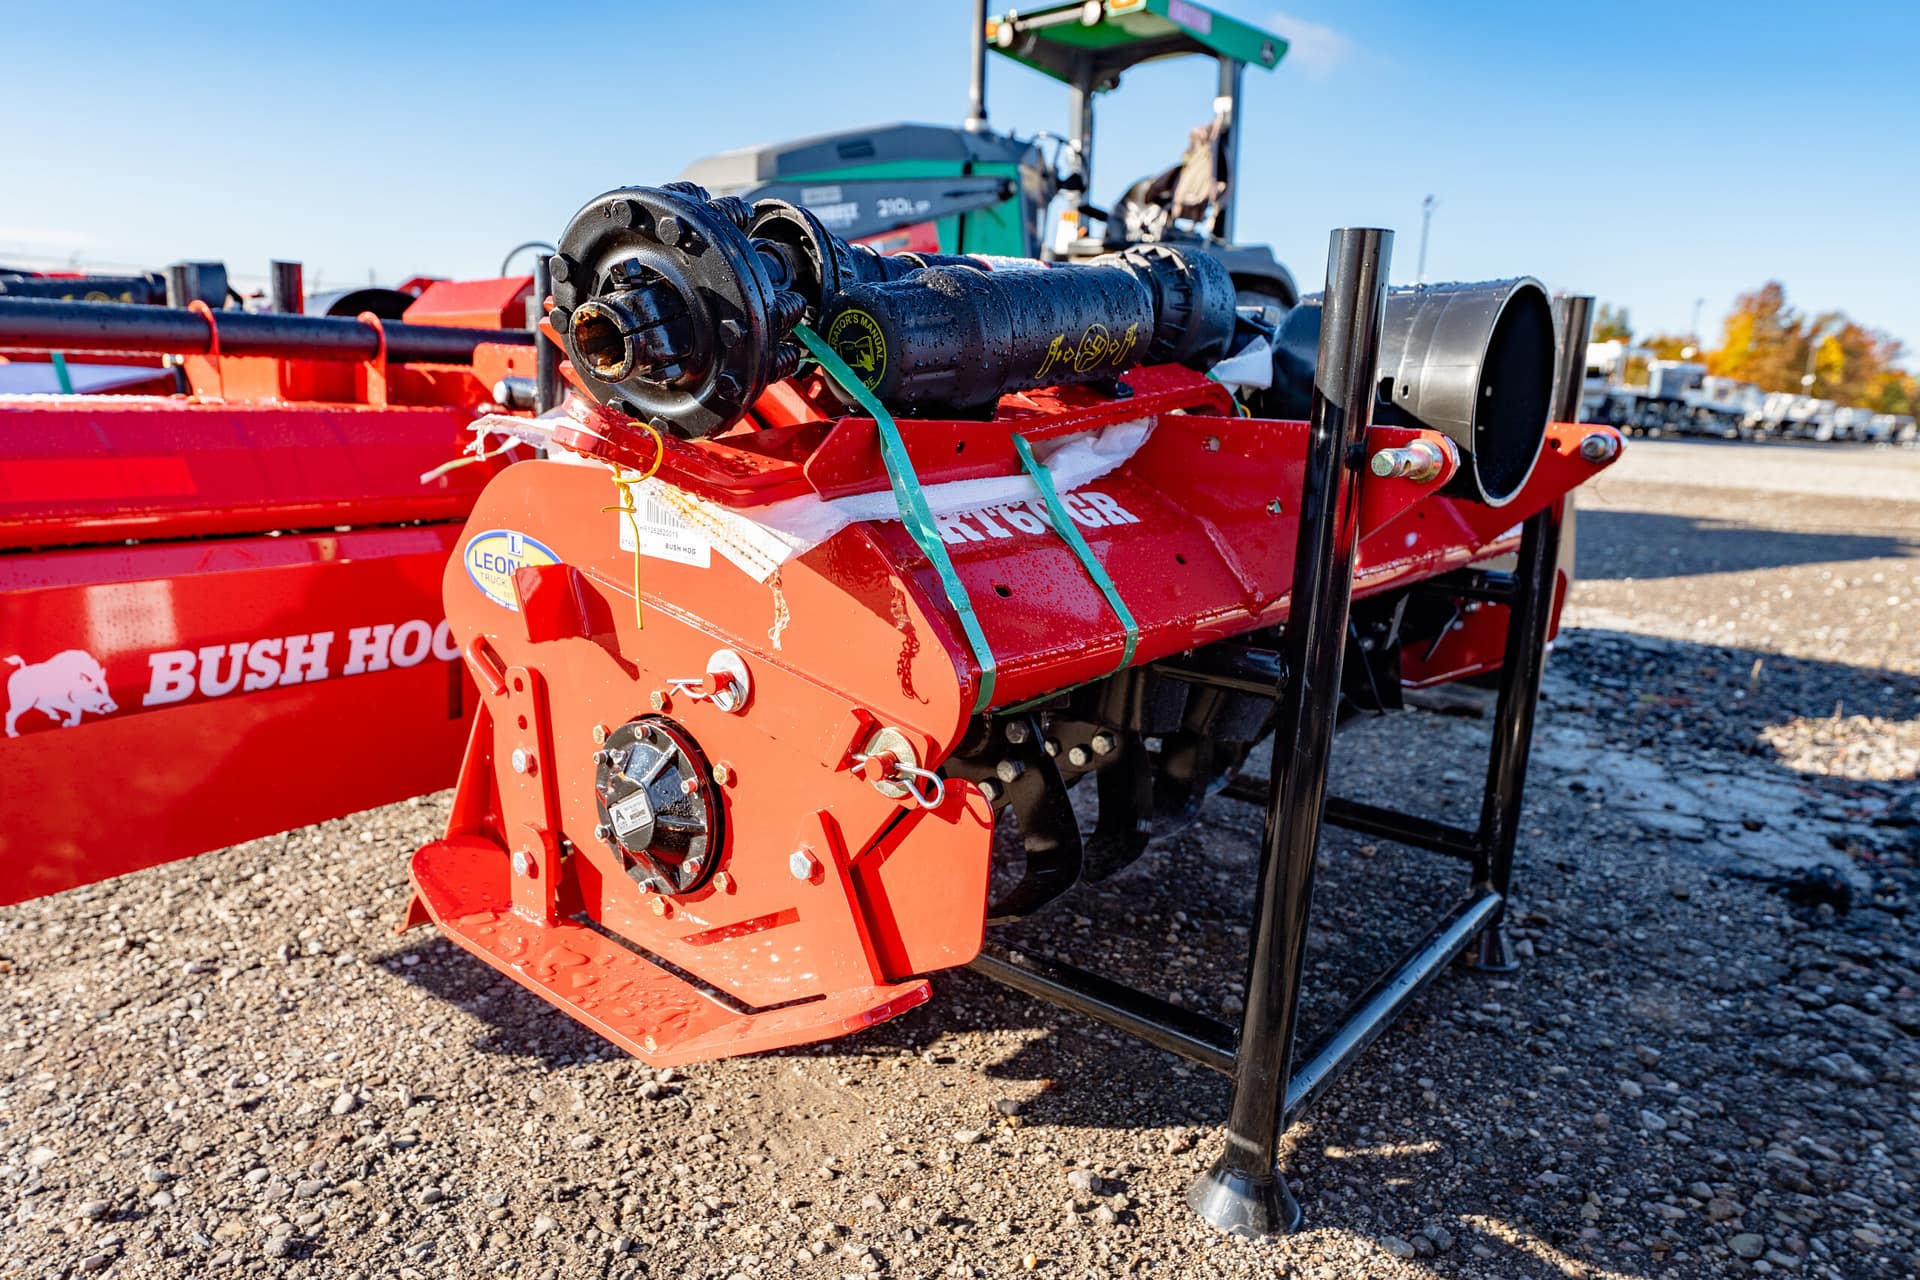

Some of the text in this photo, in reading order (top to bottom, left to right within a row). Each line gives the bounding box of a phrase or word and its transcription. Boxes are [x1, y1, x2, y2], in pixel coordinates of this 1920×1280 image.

[831, 314, 884, 361] RATOR'S MANUAL
[474, 550, 530, 577] LEON
[665, 543, 697, 556] BUSH HOG
[142, 631, 334, 706] BUSH
